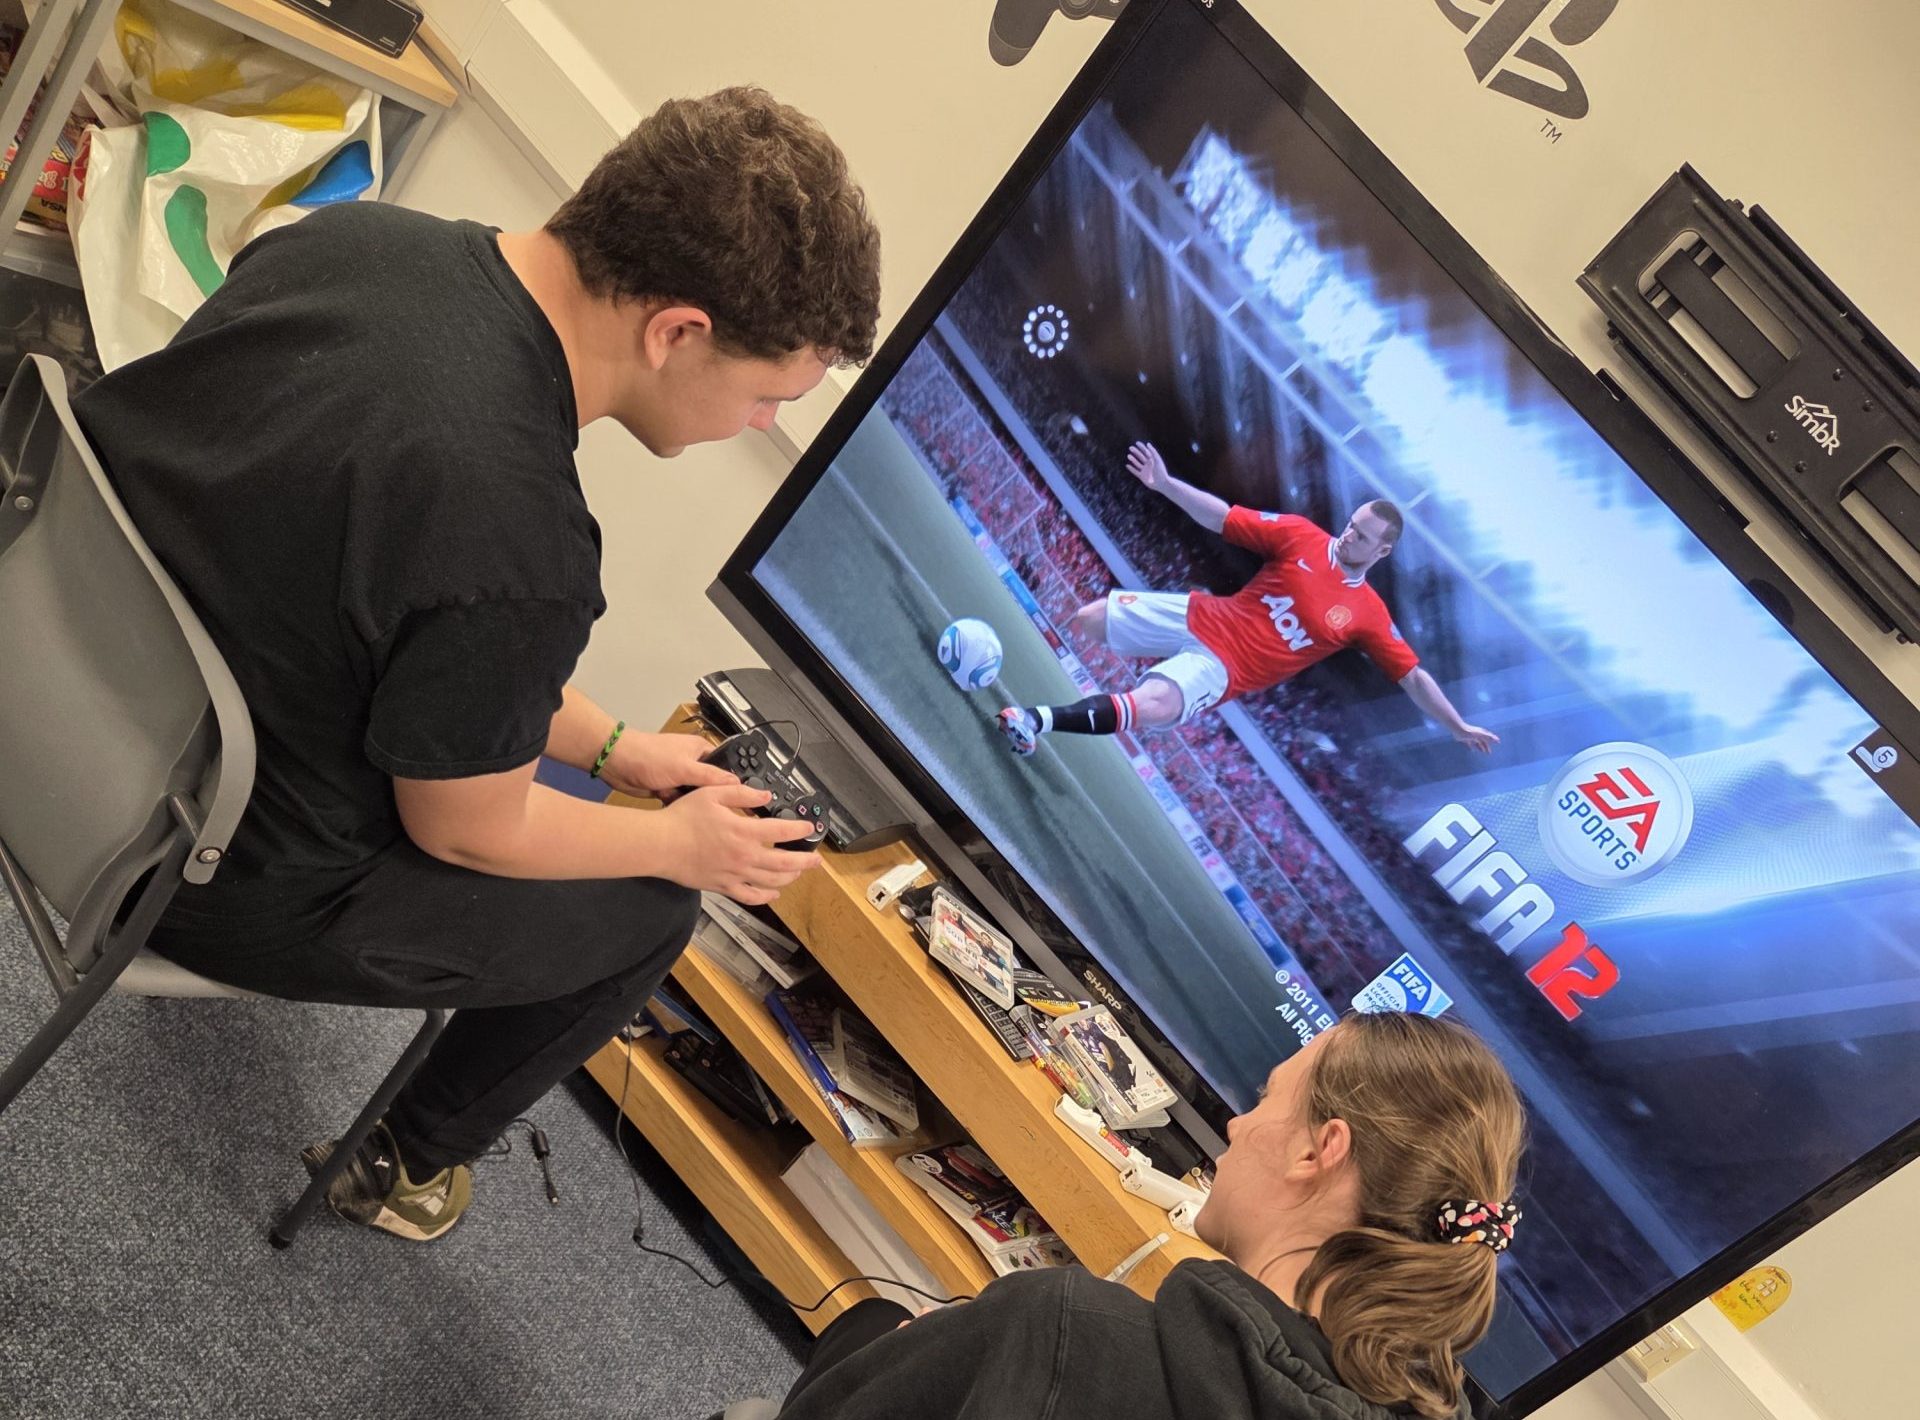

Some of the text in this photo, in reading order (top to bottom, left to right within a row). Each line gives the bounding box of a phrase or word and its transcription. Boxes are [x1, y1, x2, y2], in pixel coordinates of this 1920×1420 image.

[1260, 594, 1314, 652] AON
[1558, 790, 1637, 870] SPORTS
[1576, 766, 1661, 855] EA
[1402, 803, 1621, 1022] FIFA 12
[1083, 969, 1122, 1010] SHARP
[1285, 982, 1320, 1016] 2011
[1393, 962, 1429, 1001] FIFA
[1275, 1002, 1315, 1046] All Rig
